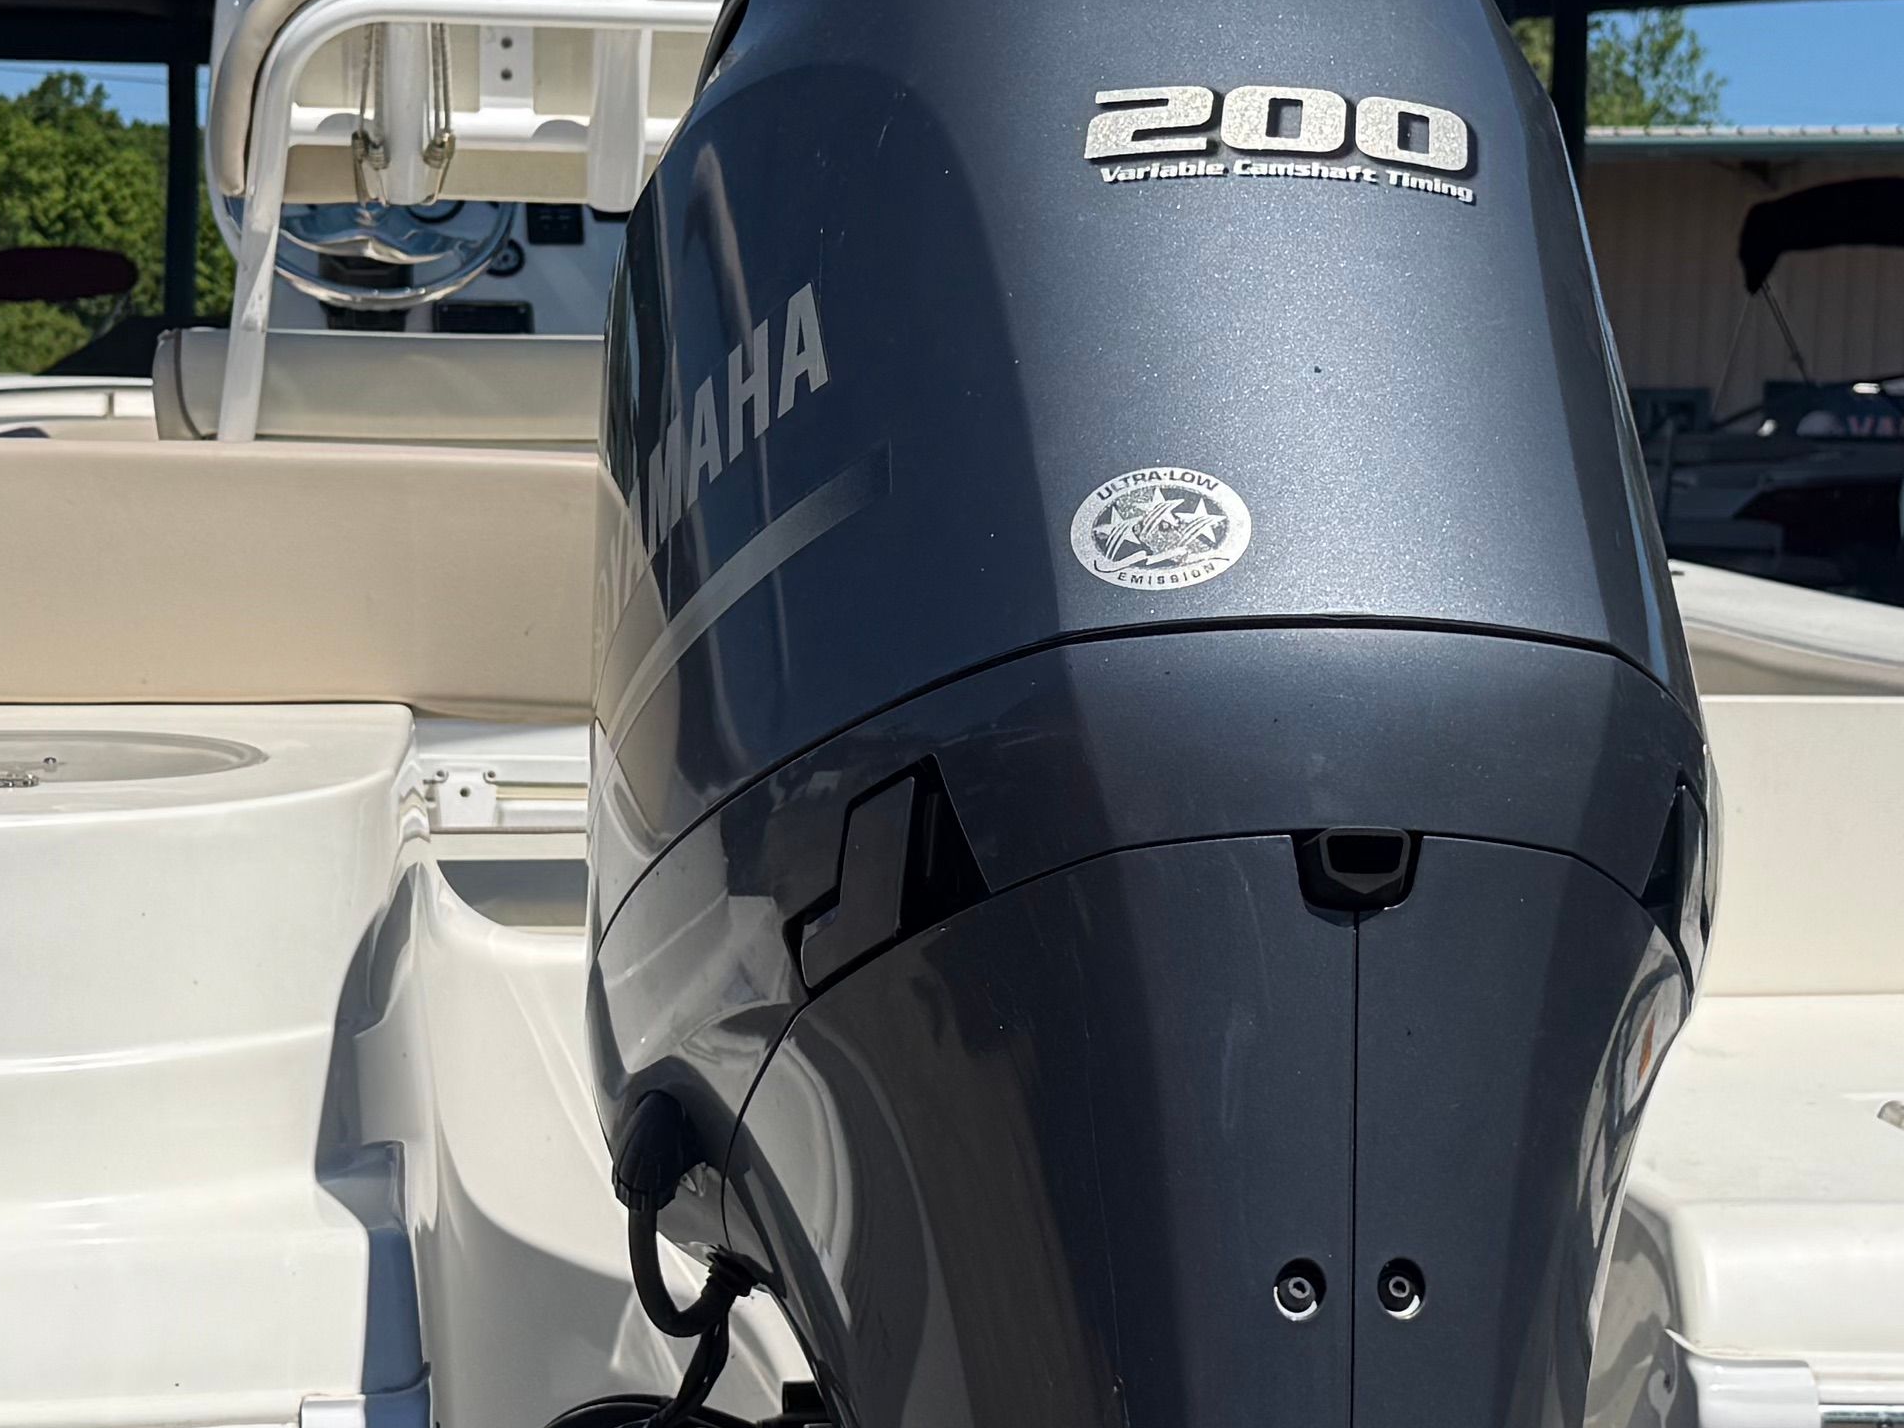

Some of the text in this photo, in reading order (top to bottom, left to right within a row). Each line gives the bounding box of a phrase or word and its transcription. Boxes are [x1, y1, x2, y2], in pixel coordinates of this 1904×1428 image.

[1084, 85, 1470, 171] 200
[1100, 158, 1475, 203] Variable Camshaft Timing
[1117, 562, 1216, 585] EMISSION
